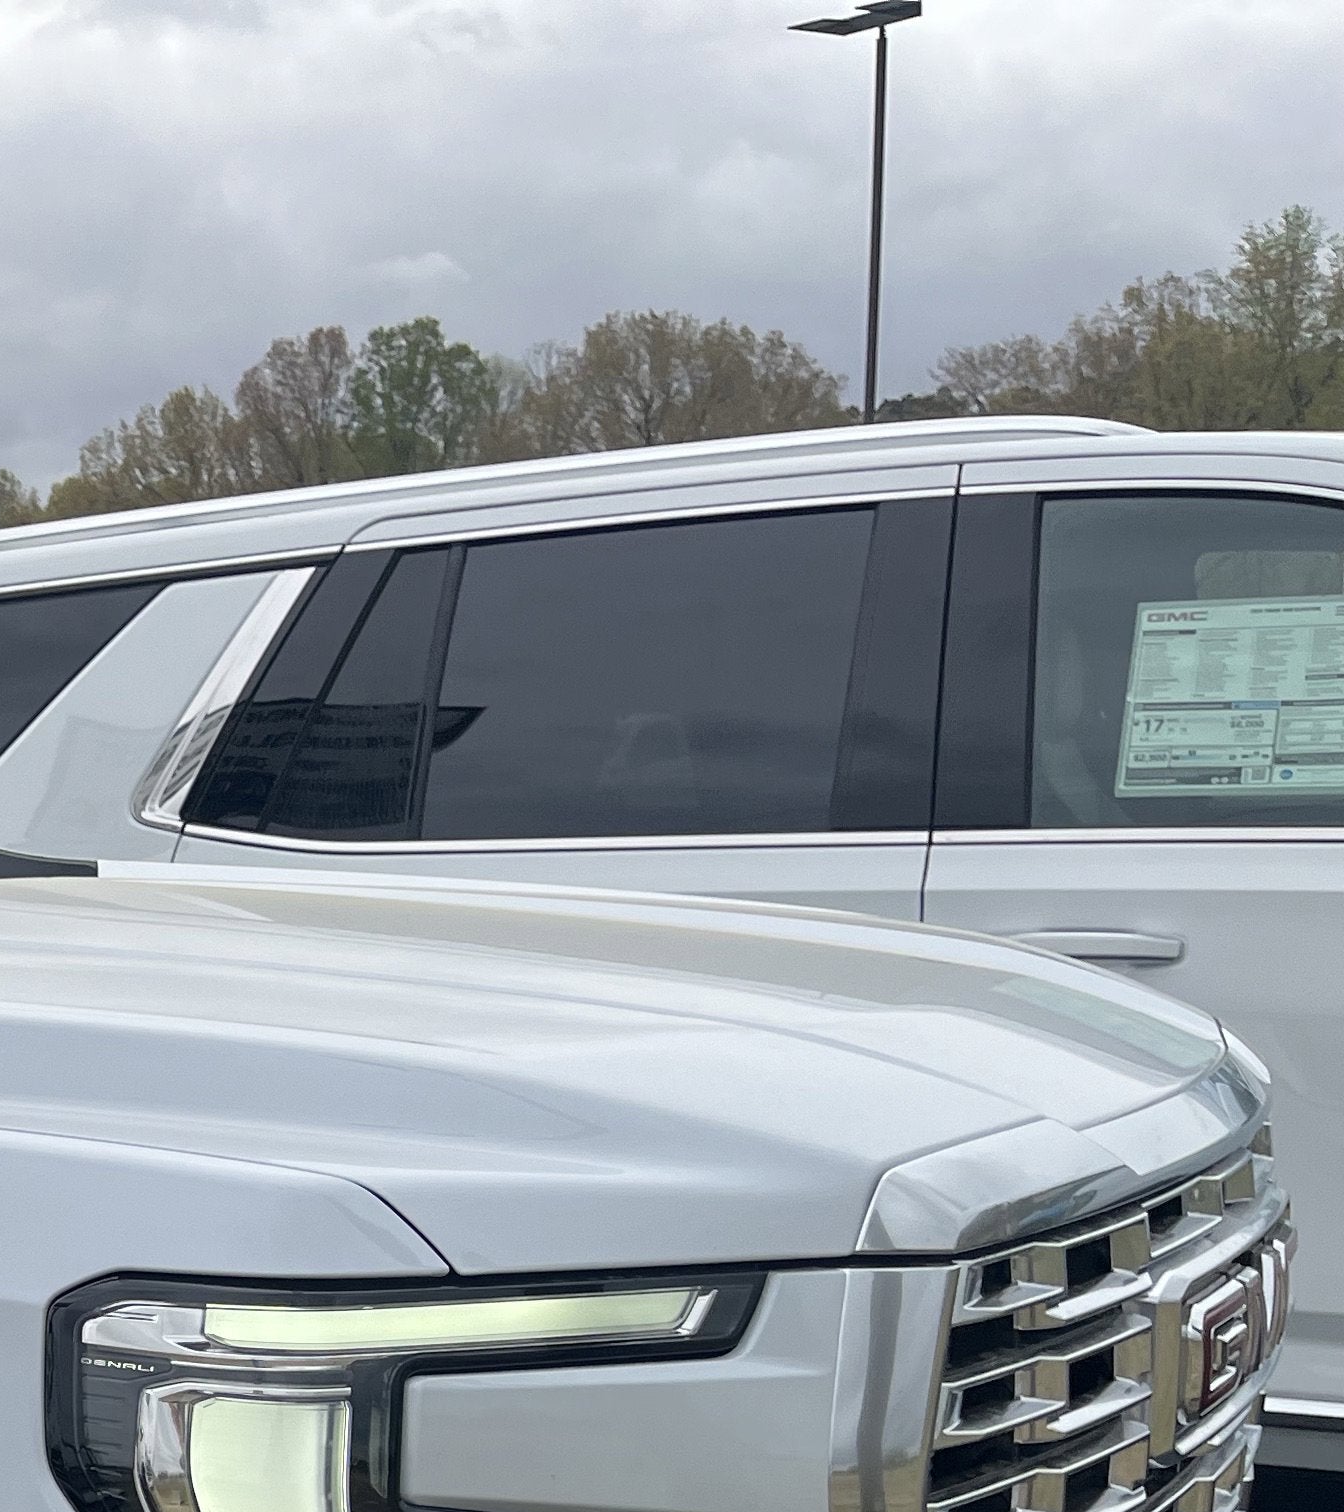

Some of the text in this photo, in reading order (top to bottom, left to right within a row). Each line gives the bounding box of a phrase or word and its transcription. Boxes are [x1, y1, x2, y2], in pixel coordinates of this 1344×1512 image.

[1147, 610, 1209, 623] GMC
[1145, 719, 1165, 732] 17
[80, 1356, 155, 1373] DENALI
